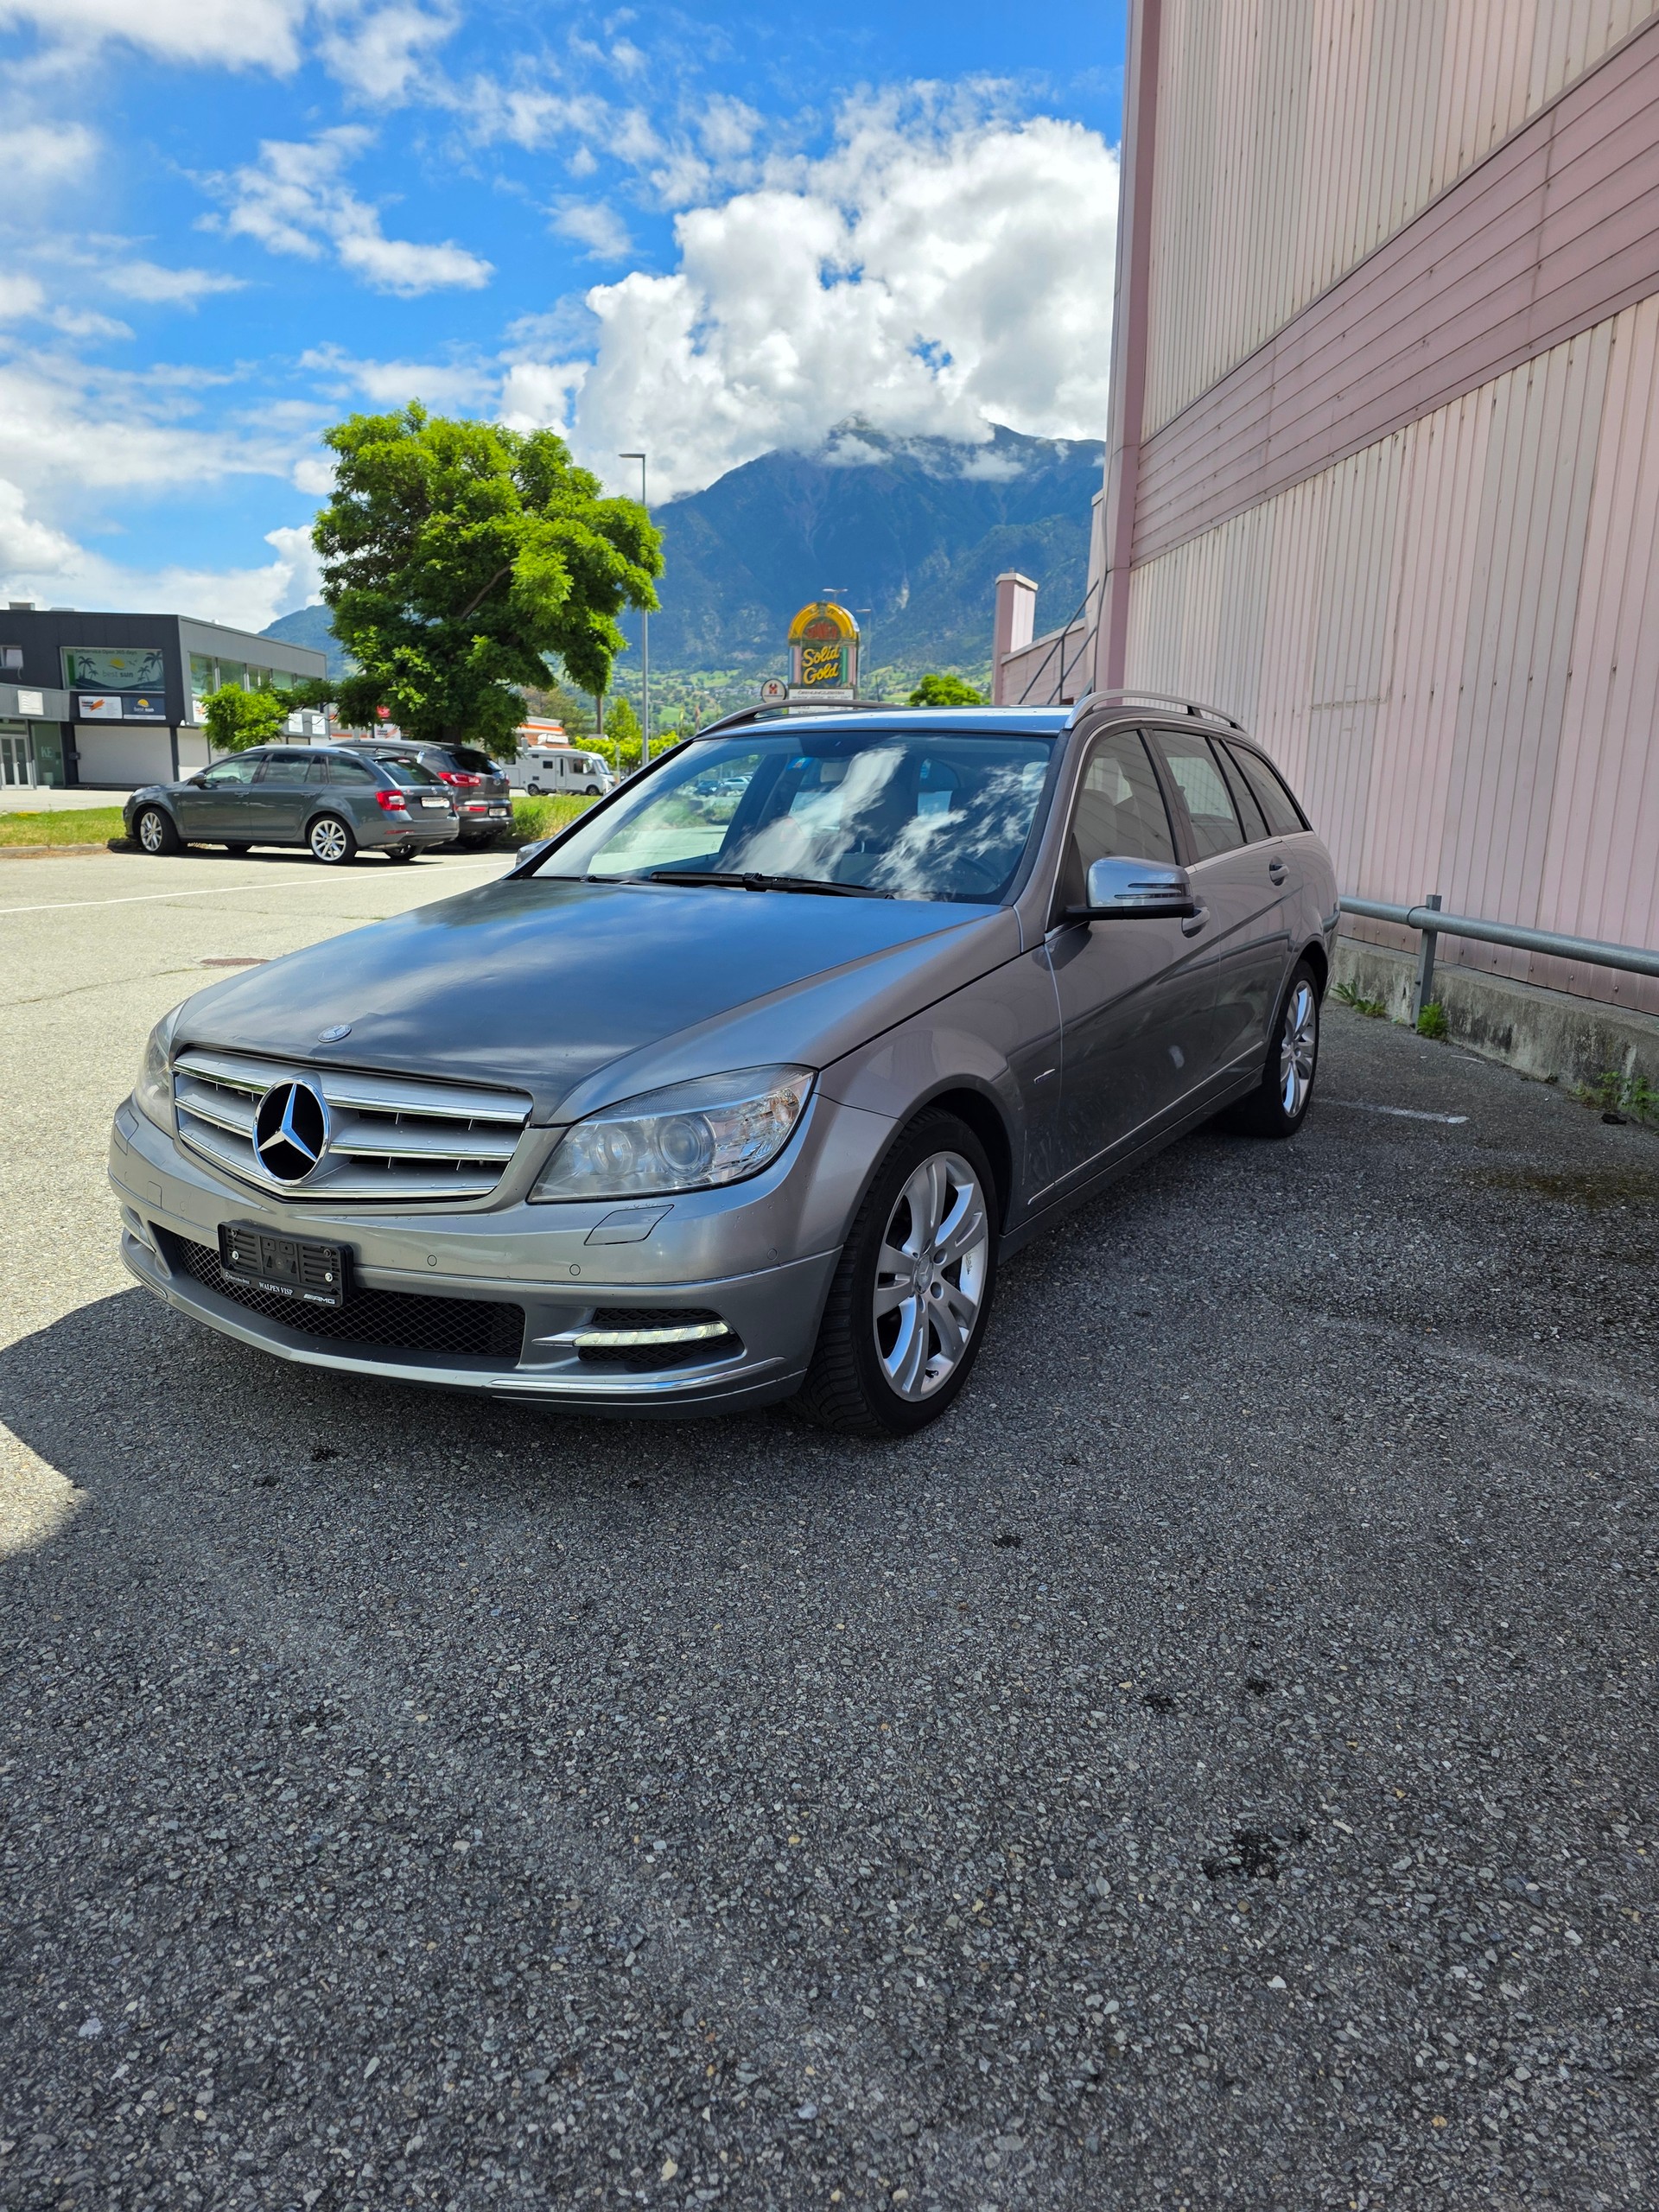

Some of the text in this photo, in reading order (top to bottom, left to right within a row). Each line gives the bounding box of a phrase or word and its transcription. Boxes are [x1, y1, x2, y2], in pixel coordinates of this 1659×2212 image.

[802, 644, 840, 667] Solid
[803, 663, 839, 685] Gold
[258, 1281, 294, 1296] WALPEN VISP
[312, 1295, 336, 1305] AMG
